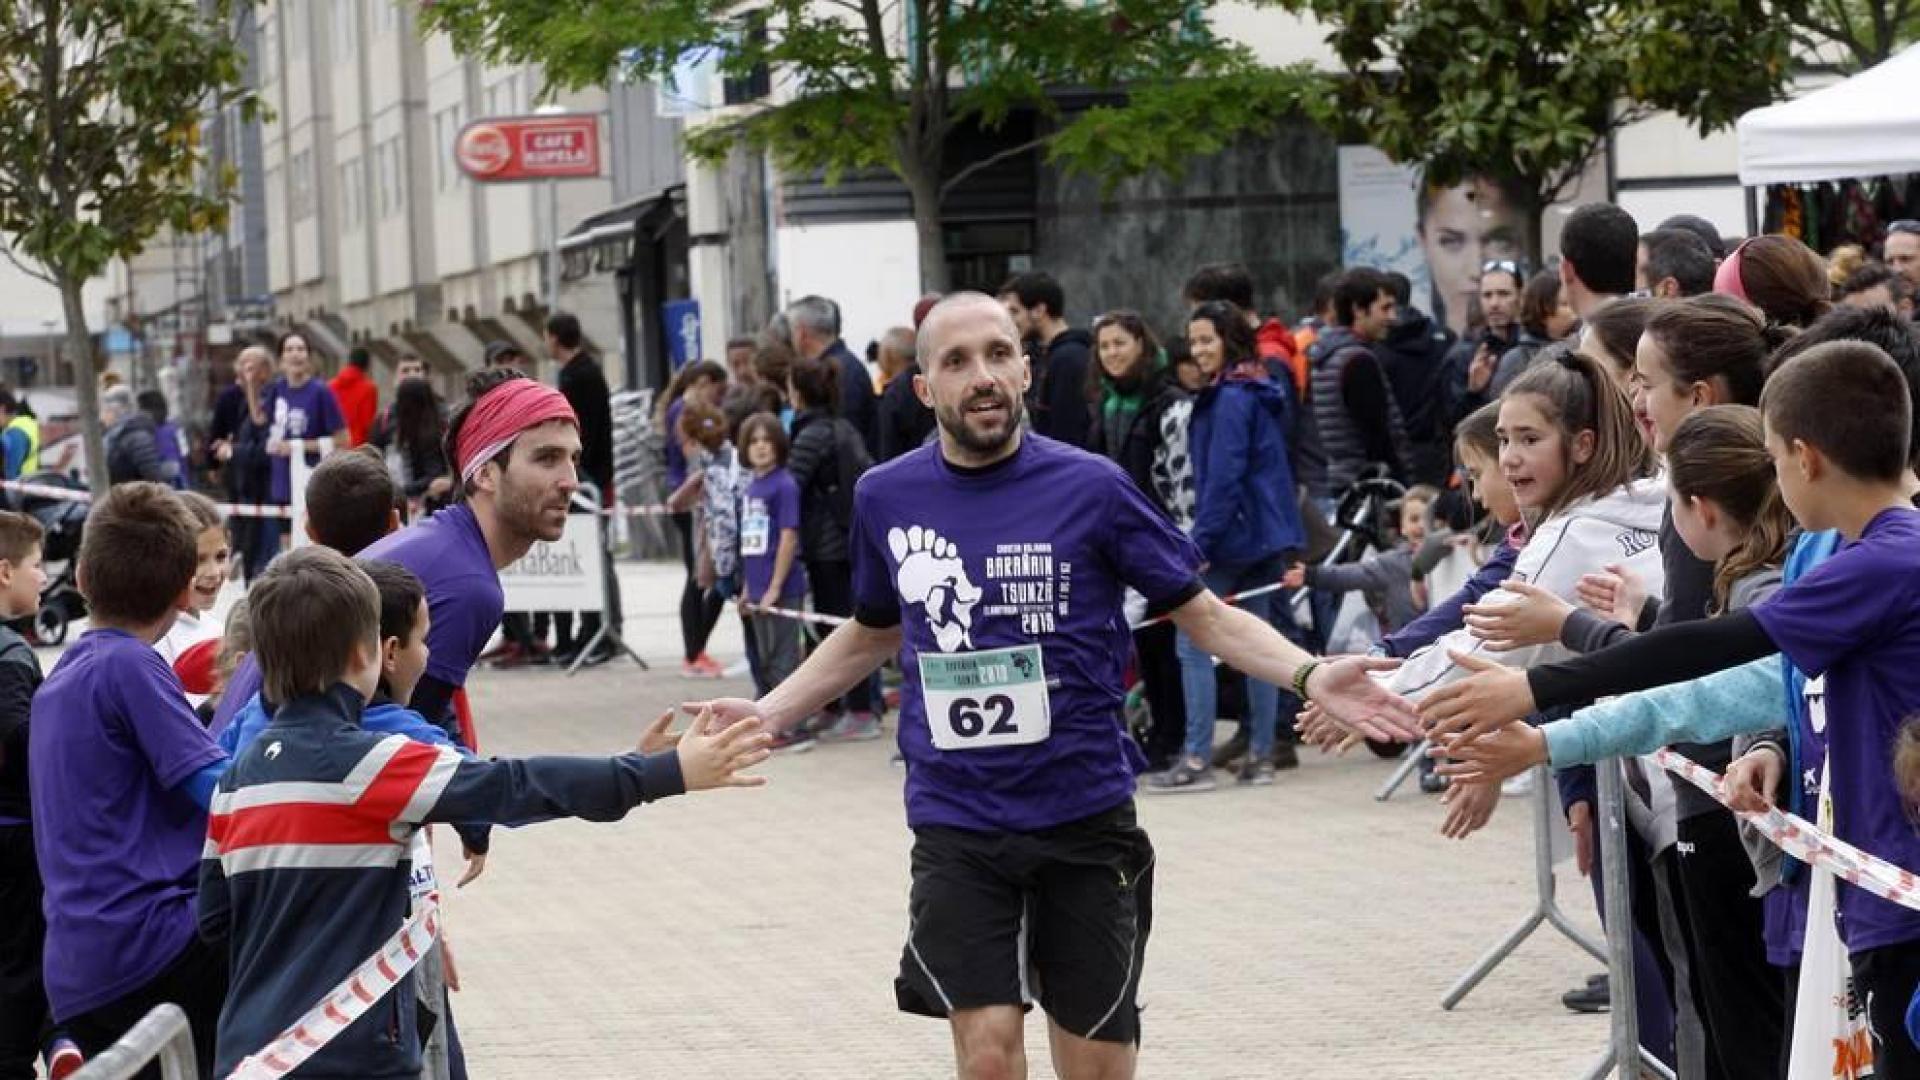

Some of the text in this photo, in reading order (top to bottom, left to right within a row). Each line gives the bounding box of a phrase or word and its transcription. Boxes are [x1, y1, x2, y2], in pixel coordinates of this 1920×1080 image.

[504, 541, 584, 575] xaBank
[986, 553, 1053, 578] BARAÑAIN
[1022, 612, 1055, 634] 2018
[949, 693, 1018, 738] 62
